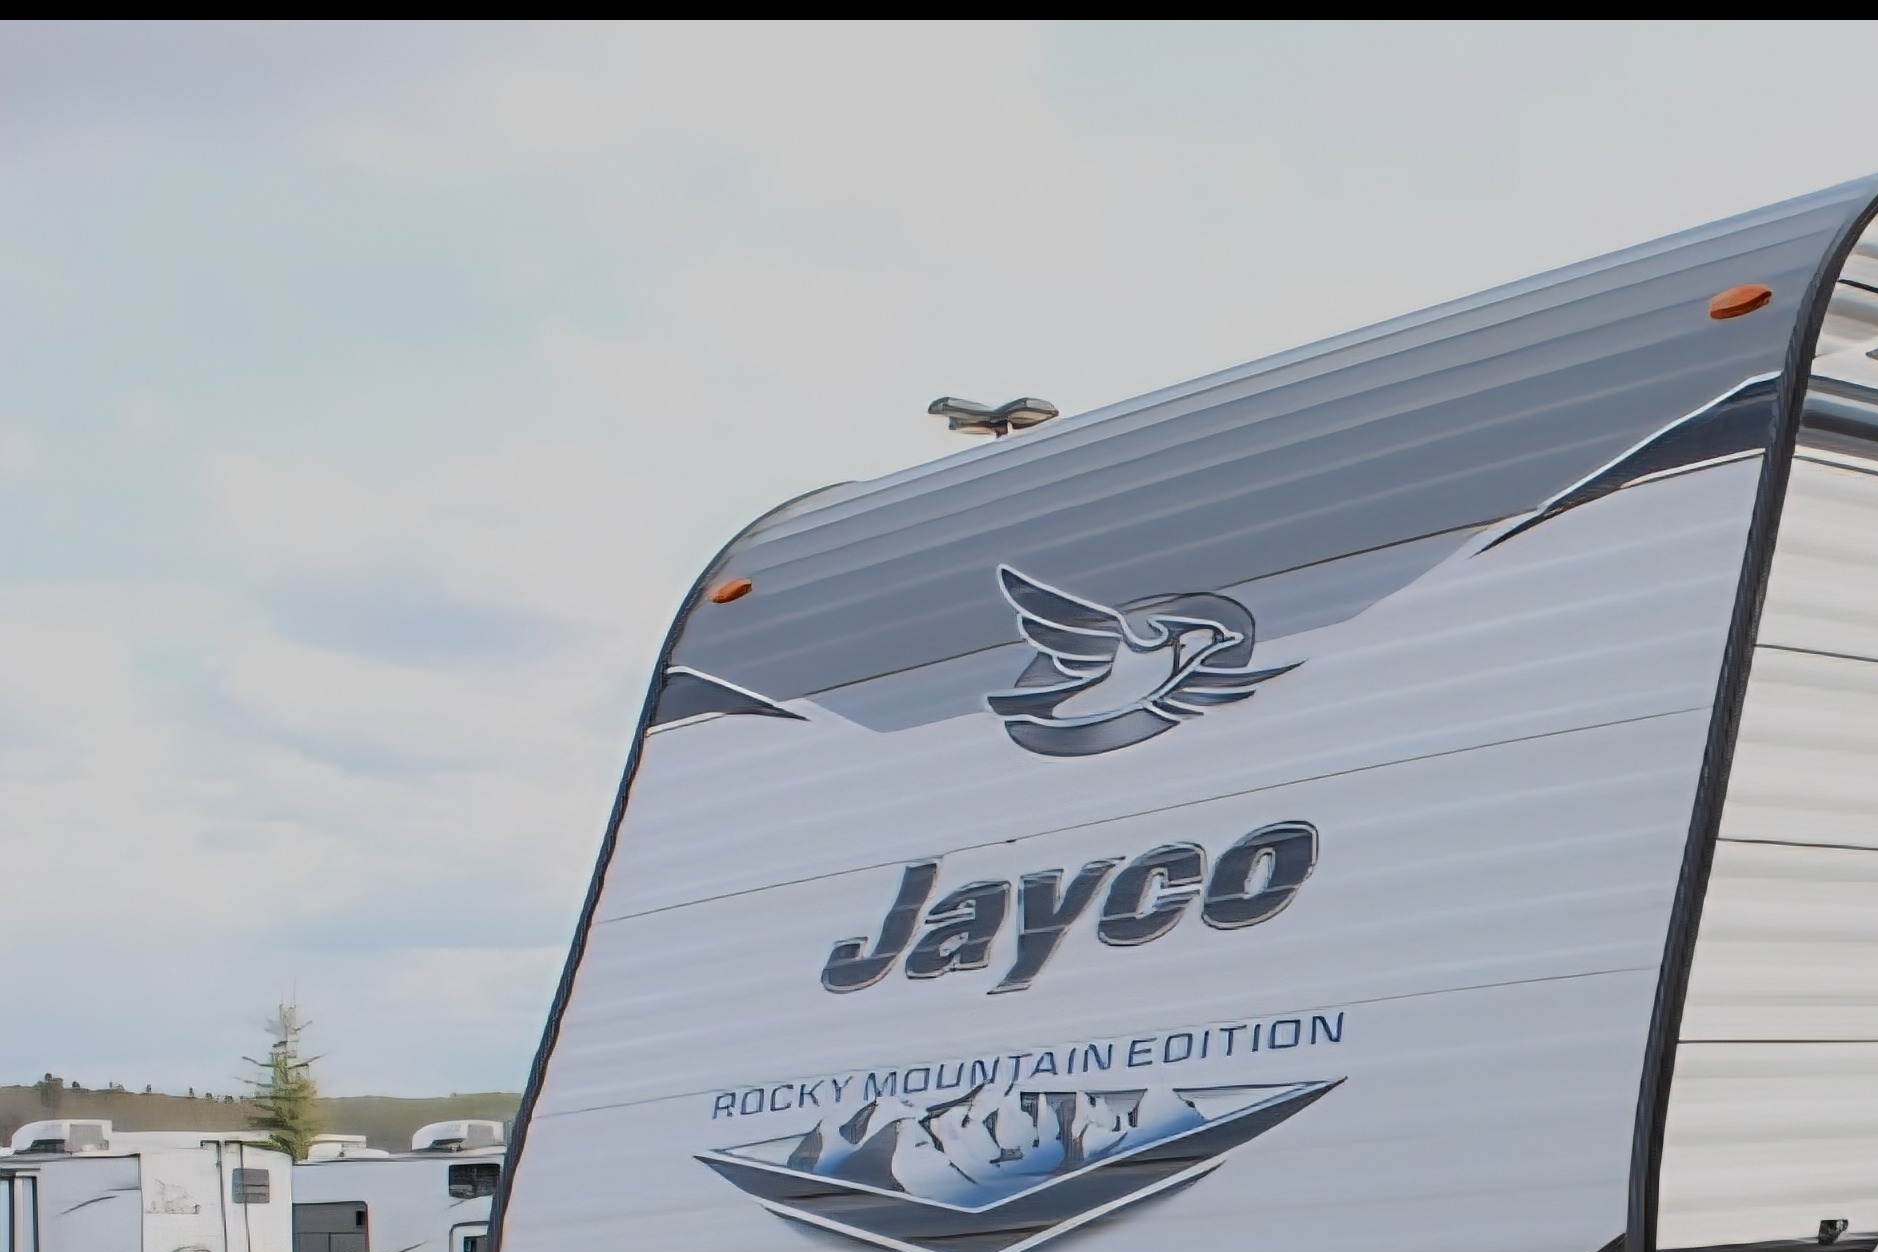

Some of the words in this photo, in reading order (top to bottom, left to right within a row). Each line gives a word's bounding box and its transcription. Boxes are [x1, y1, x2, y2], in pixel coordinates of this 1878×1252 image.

[821, 819, 1320, 995] Jayco
[712, 1075, 854, 1121] ROCKY
[863, 1042, 1114, 1102] MOUNTAIN
[1127, 1011, 1346, 1068] EDITION
